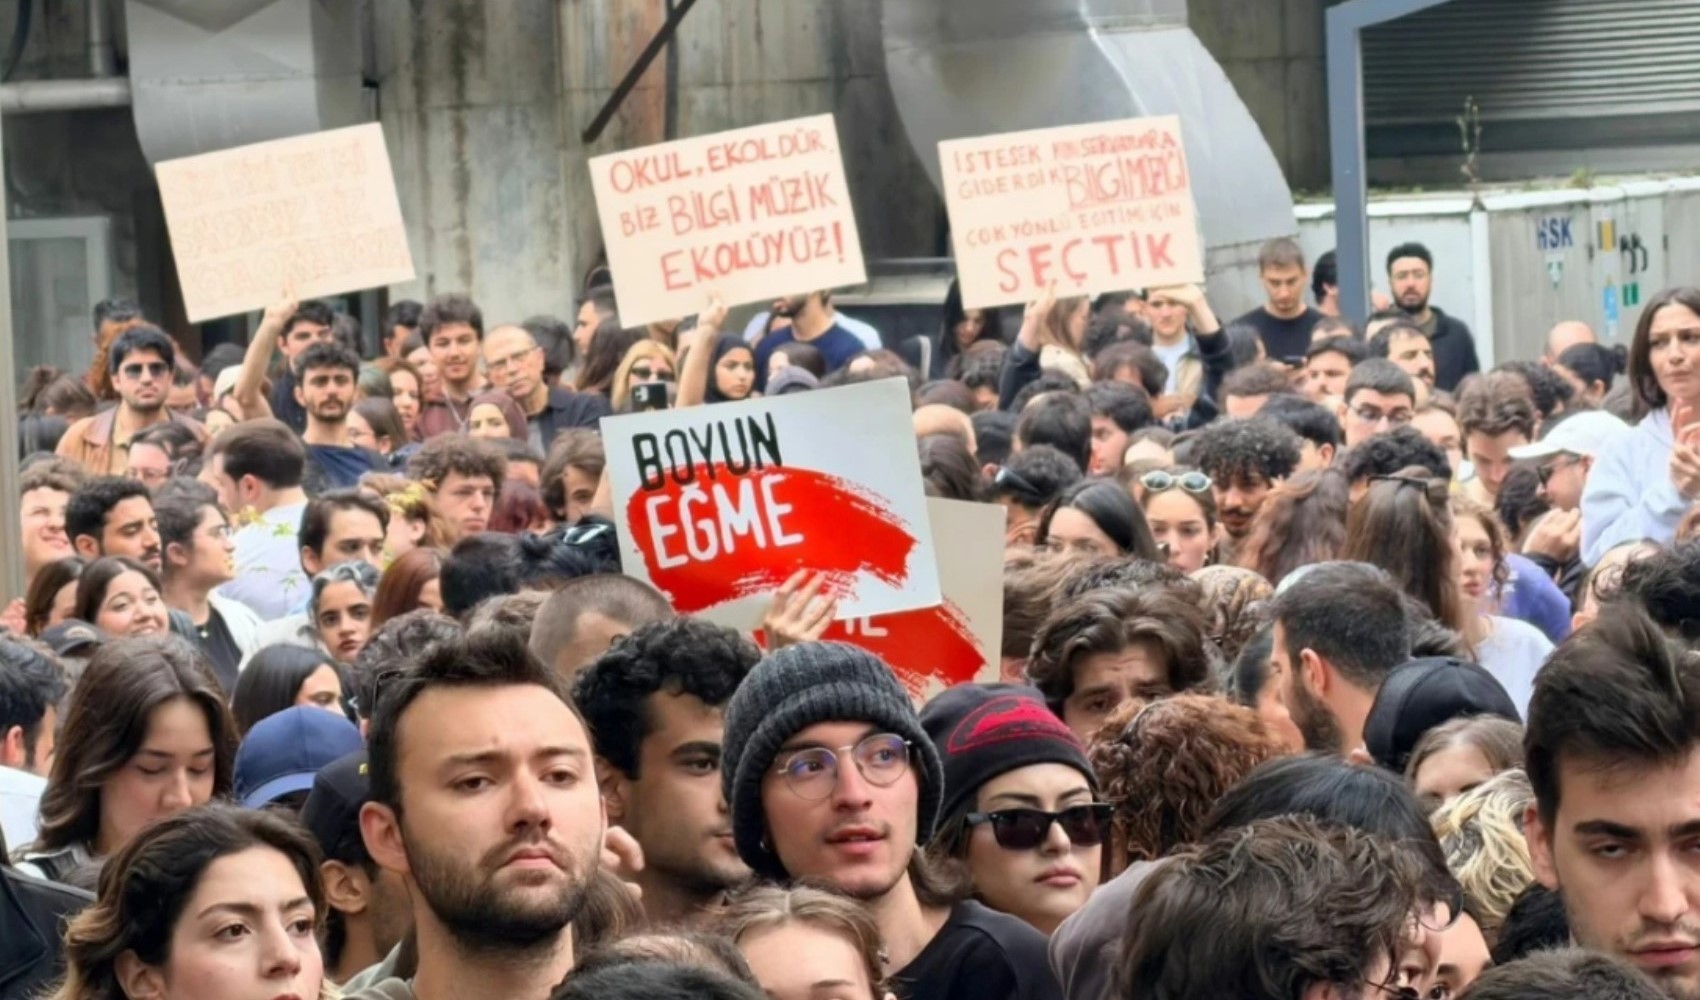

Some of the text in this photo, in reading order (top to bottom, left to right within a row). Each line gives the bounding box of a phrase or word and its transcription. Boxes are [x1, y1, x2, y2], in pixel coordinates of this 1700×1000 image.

[620, 170, 838, 237] BİZ BİLGİ MÜZİK
[660, 220, 845, 291] EKOLÜYÜZ!
[996, 230, 1177, 294] SEÇTİK
[632, 411, 783, 491] BOYUN
[645, 473, 804, 569] EĞME
